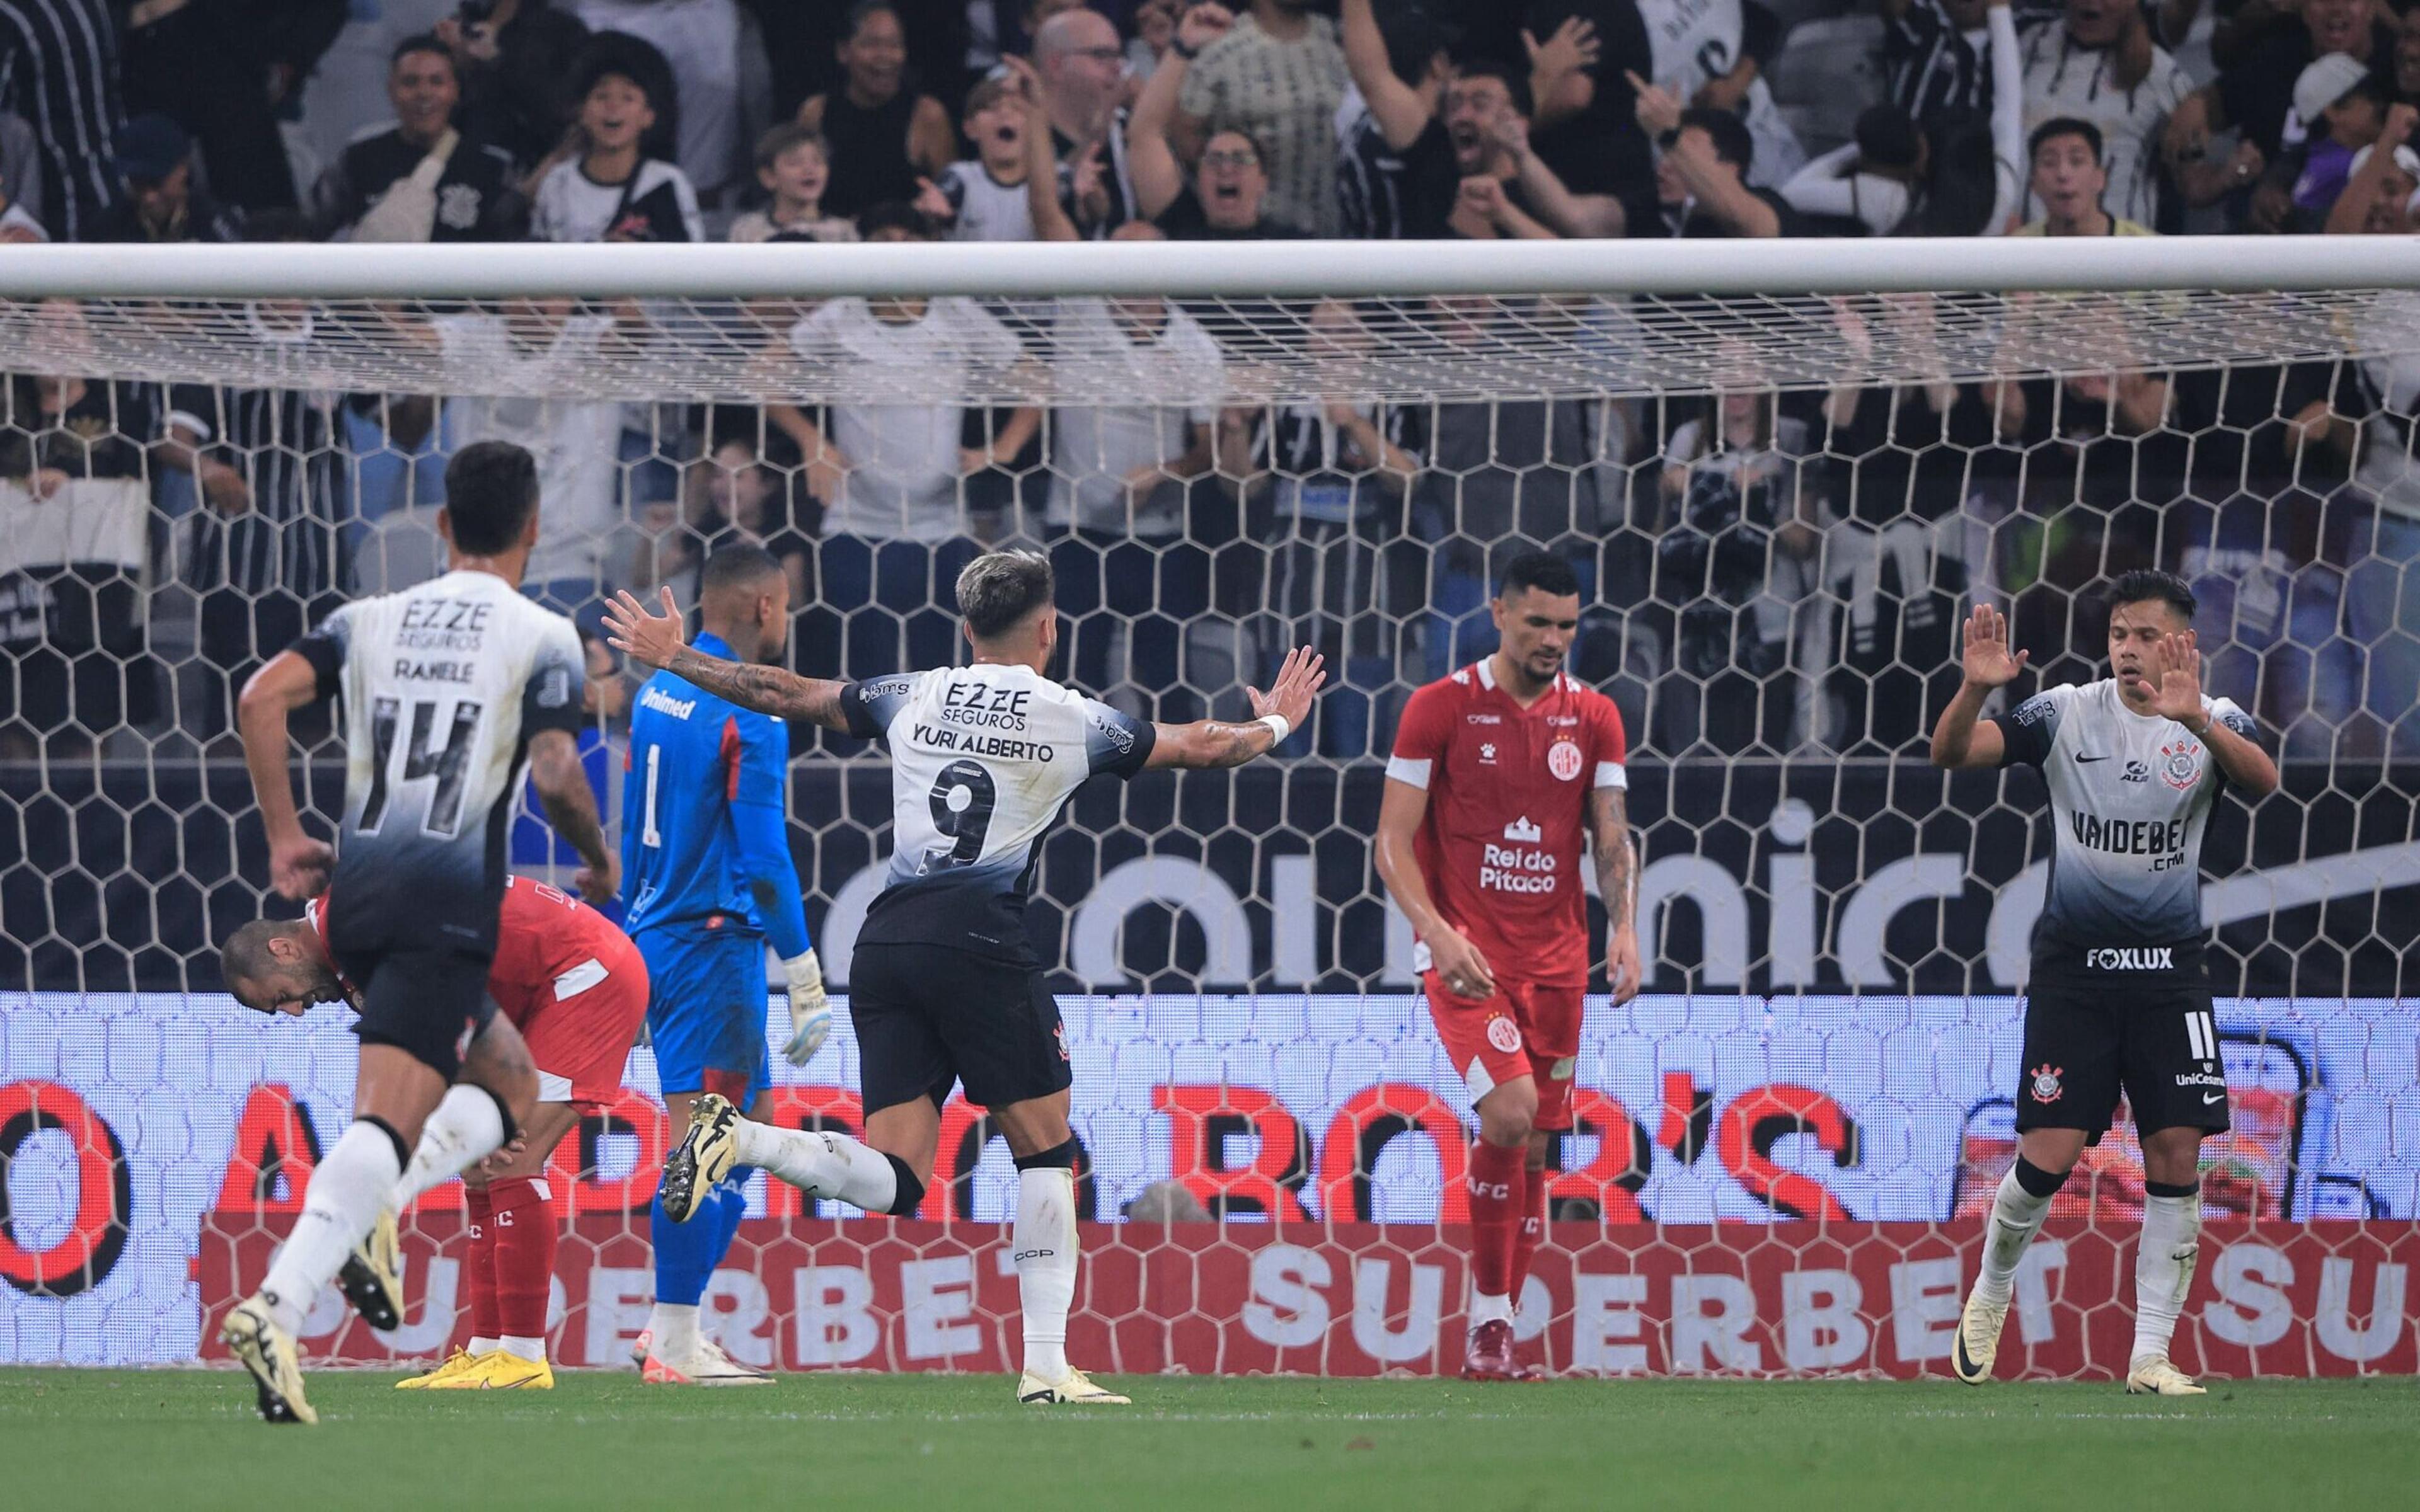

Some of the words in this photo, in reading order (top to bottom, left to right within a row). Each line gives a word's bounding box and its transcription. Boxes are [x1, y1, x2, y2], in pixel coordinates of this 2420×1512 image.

[401, 599, 493, 631] EZZE
[640, 687, 696, 721] Unimed
[945, 683, 1030, 717] EZZE
[941, 709, 1026, 731] SEGUROS
[913, 724, 959, 750] YURI
[960, 735, 1053, 762] ALBERTO
[353, 696, 484, 842] 14
[643, 744, 661, 848] 1
[916, 757, 998, 876] 9
[1484, 844, 1522, 869] Rei
[1524, 849, 1556, 872] do
[1480, 866, 1555, 893] Pitaco
[2087, 948, 2174, 970] FOXLUX
[2185, 1011, 2215, 1060] 11
[267, 1240, 1017, 1366] UERBE
